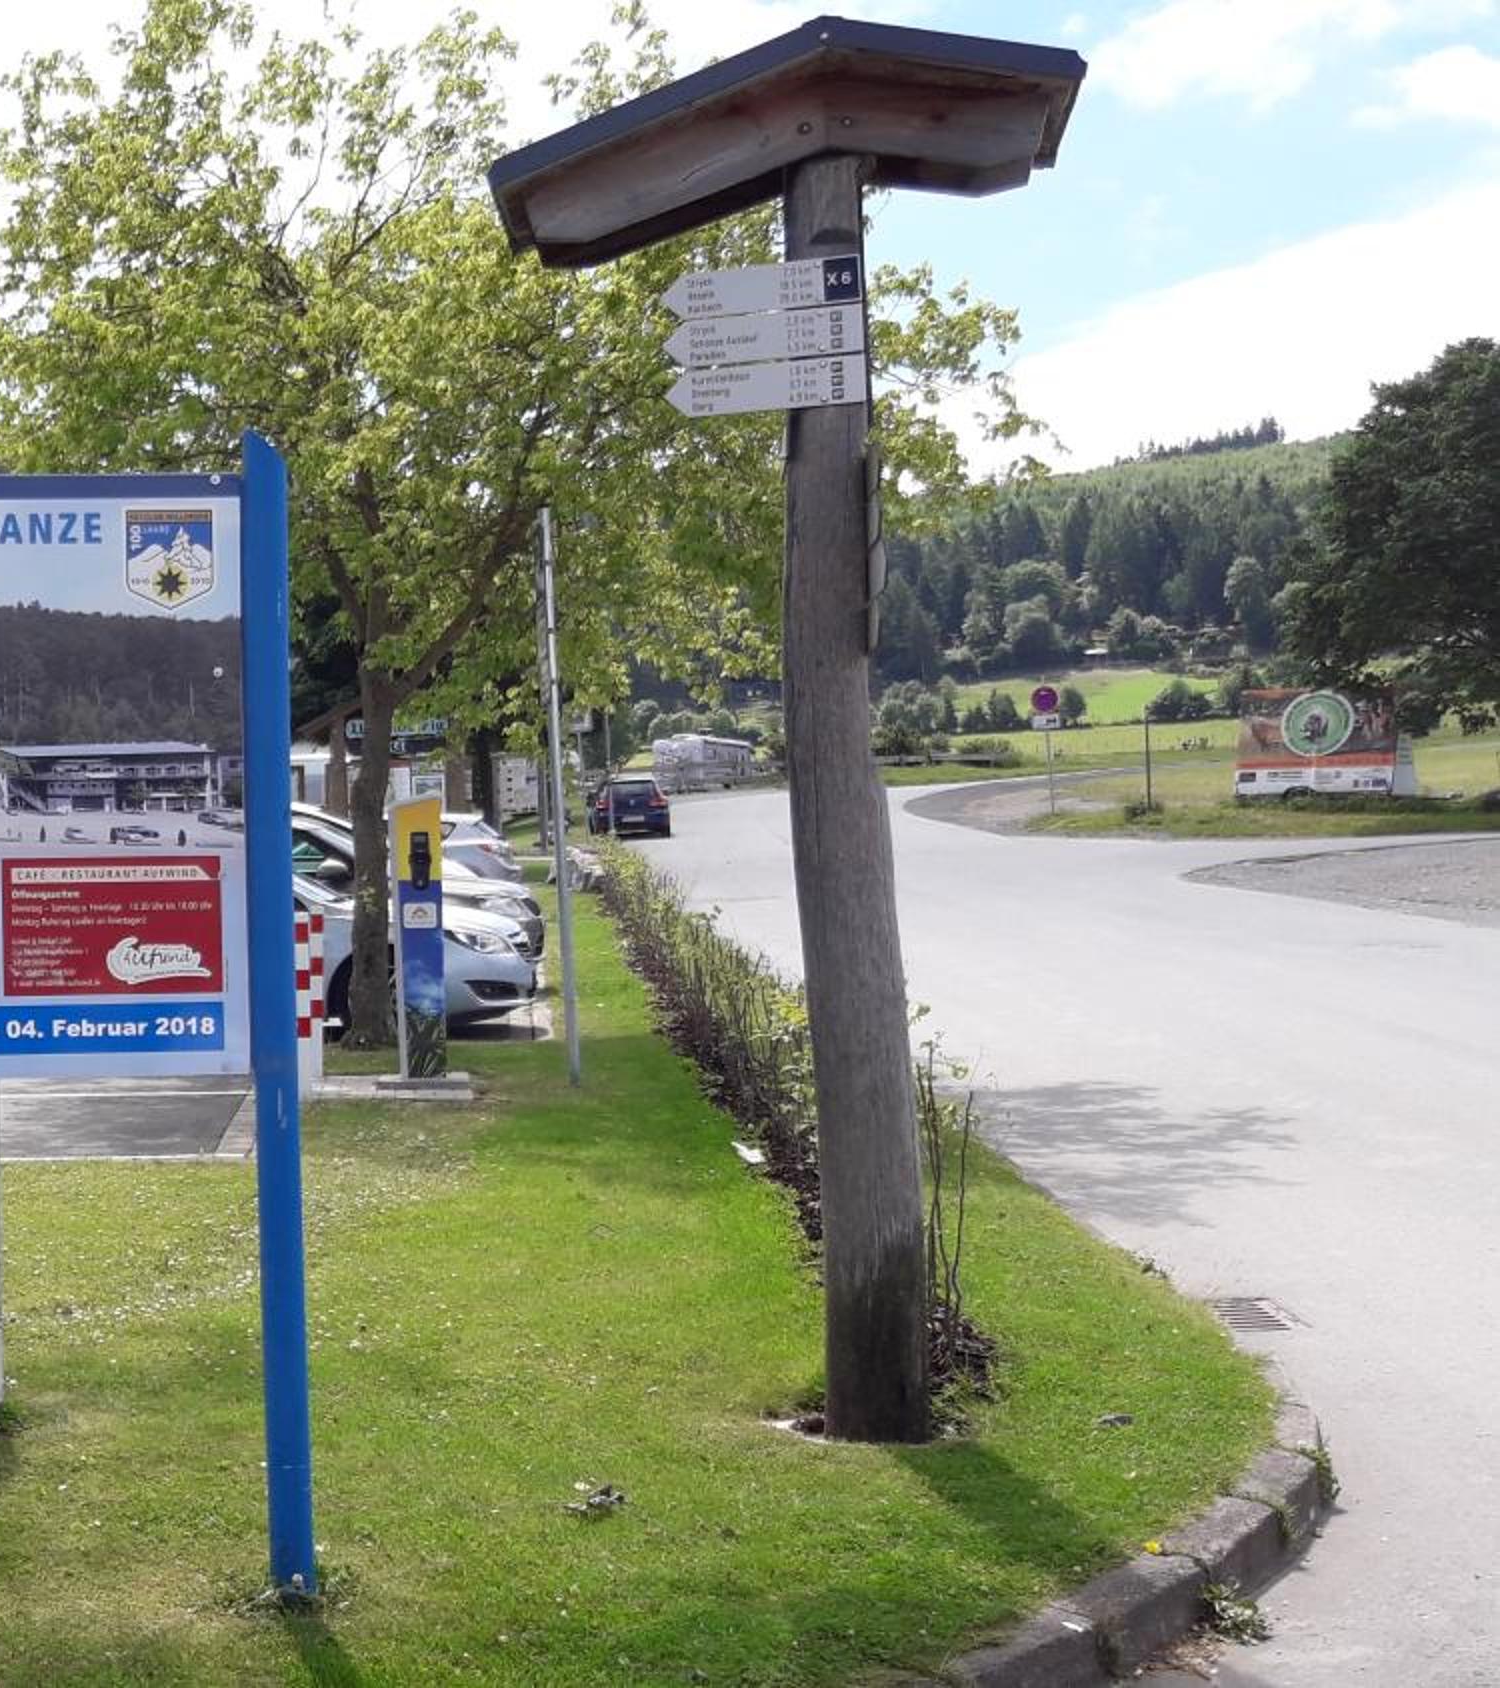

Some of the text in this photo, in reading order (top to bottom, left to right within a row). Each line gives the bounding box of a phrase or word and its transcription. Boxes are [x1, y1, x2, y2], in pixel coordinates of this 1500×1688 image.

[17, 869, 46, 881] CAFÉ
[61, 868, 138, 880] RESTAURANT
[142, 867, 199, 879] AUFWIND
[5, 1019, 46, 1040] 04.
[52, 1016, 147, 1038] Februar
[153, 1015, 216, 1037] 2018
